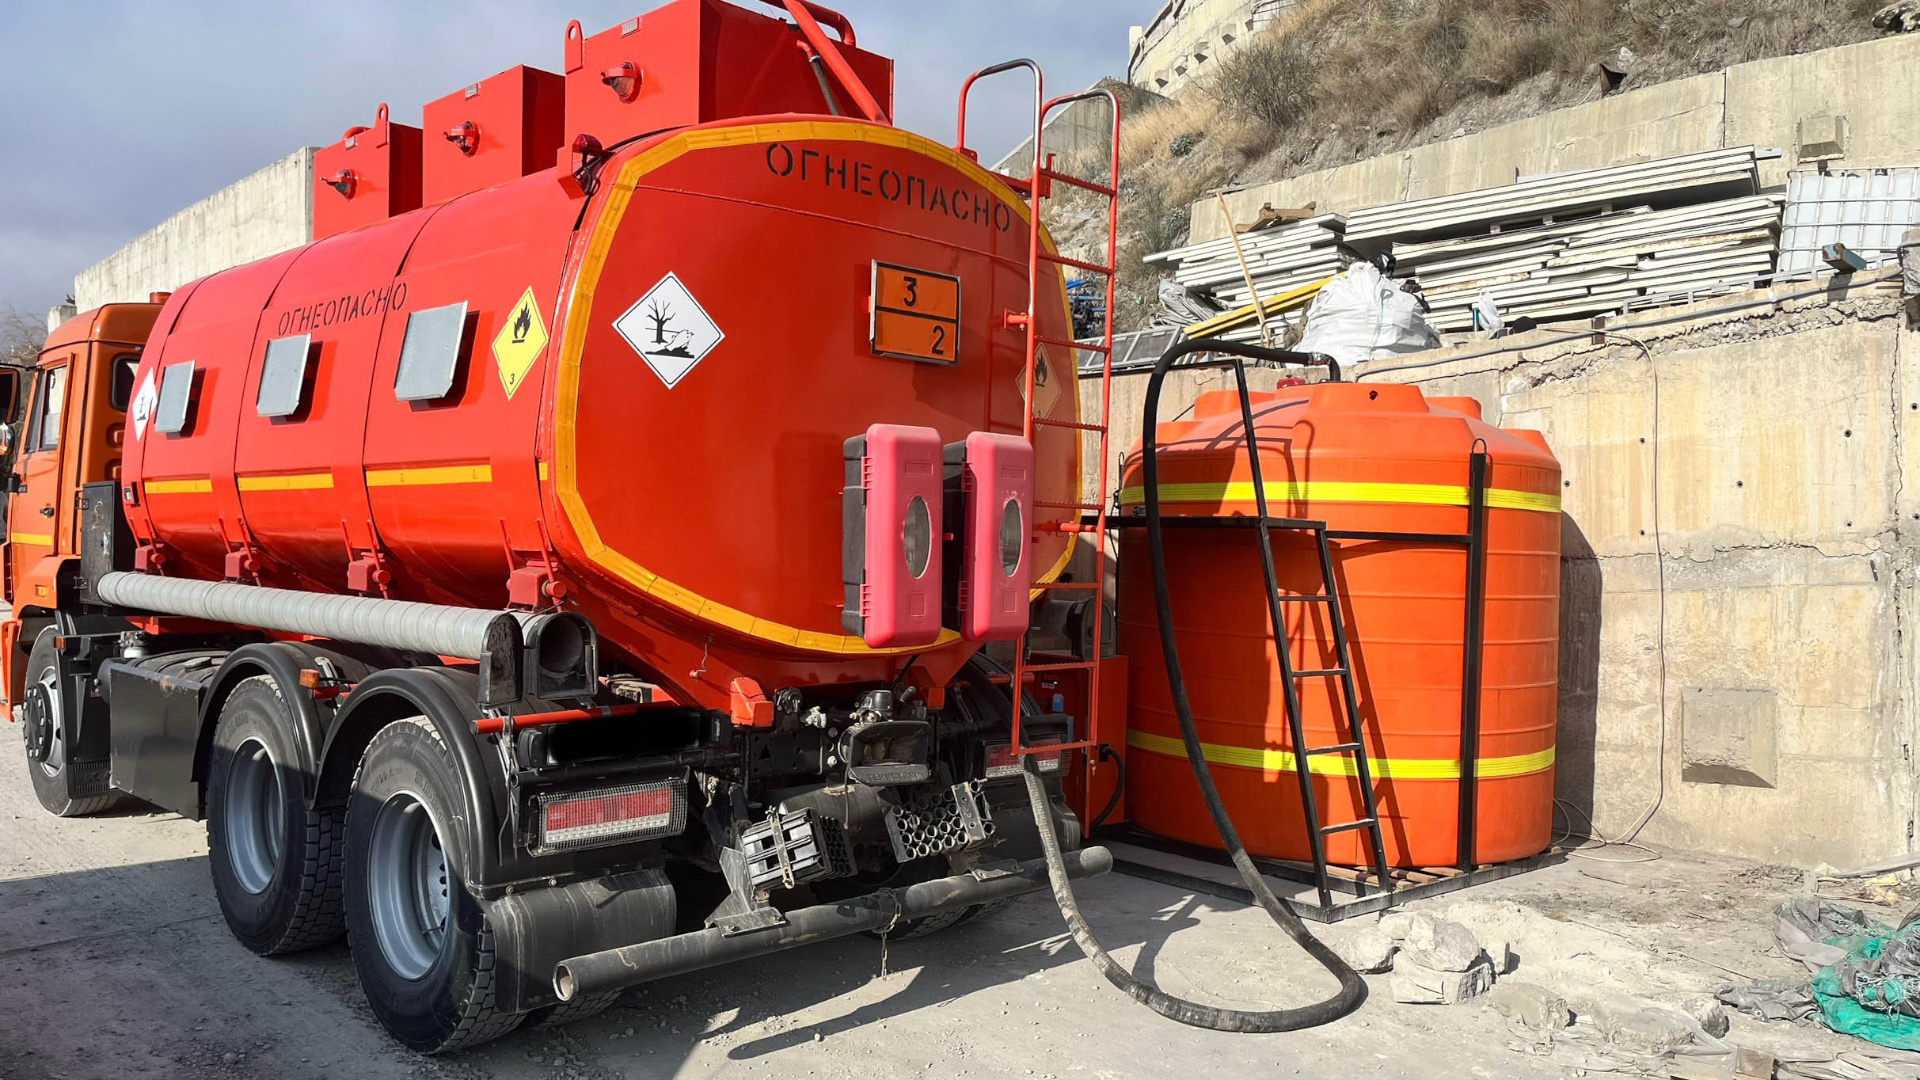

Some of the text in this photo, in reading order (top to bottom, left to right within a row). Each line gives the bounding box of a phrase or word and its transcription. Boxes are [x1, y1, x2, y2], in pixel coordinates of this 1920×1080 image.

[766, 142, 1011, 233] ОГНЕОПАСНО
[903, 275, 917, 307] 3
[278, 282, 407, 336] ОГНЕОПАСНО
[931, 325, 945, 355] 2
[509, 373, 515, 385] 3
